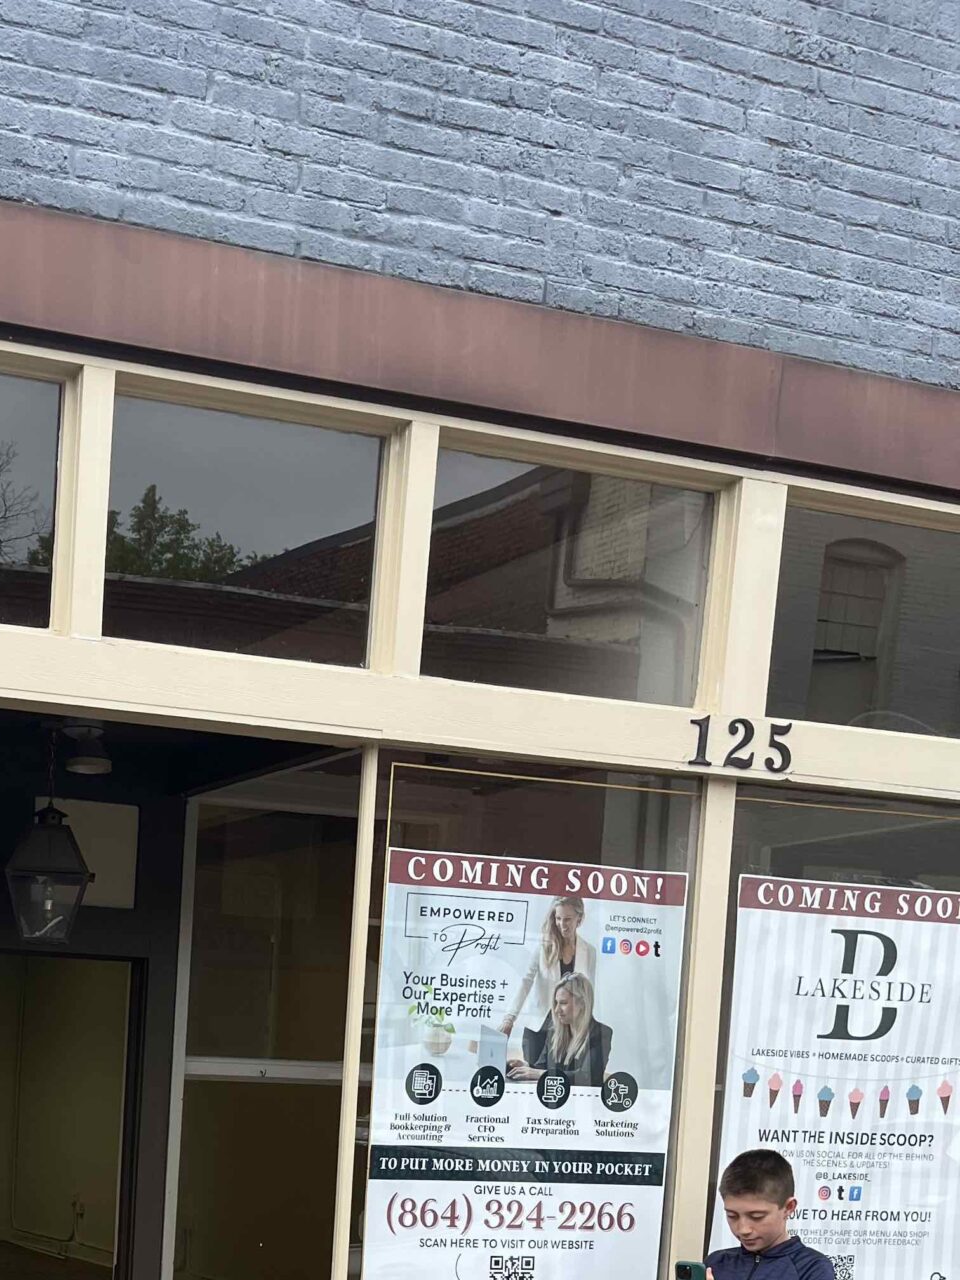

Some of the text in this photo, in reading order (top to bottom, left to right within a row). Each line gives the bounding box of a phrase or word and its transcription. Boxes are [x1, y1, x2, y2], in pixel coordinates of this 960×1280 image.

[688, 715, 792, 773] 125
[407, 856, 664, 900] COMING SOON!
[757, 882, 881, 913] COMING
[420, 906, 514, 922] EMPOWERED
[610, 914, 657, 924] LET'S CONNECT
[433, 924, 501, 967] TO Profit
[403, 971, 436, 986] Your
[440, 973, 497, 990] Business
[817, 929, 898, 1041] B
[402, 986, 429, 1000] Our
[433, 988, 494, 1006] Expertise
[794, 976, 933, 1004] LAKESIDE
[416, 1002, 492, 1018] More Profit
[751, 1048, 788, 1058] LAKESIDE
[790, 1050, 810, 1059] VIBES
[818, 1052, 868, 1062] HOMEMADE
[870, 1054, 900, 1063] SCOOPS
[905, 1056, 940, 1065] CURATED
[466, 1114, 510, 1124] Fractional
[526, 1117, 576, 1129] Tax Strategy
[594, 1120, 639, 1130] Marketing
[390, 1122, 442, 1133] Bookkeeping
[478, 1125, 495, 1134] CFO
[530, 1127, 580, 1137] Preparation
[595, 1129, 635, 1138] Solutions
[398, 1132, 444, 1143] Accounting
[468, 1134, 504, 1142] Services
[758, 1129, 935, 1148] WANT THE INSIDE SCOOP?
[816, 1150, 846, 1159] SOCIAL
[848, 1152, 863, 1160] FOR
[905, 1153, 934, 1162] BEHIND
[379, 1157, 653, 1176] TO PUT MORE MONEY IN YOUR POCKET
[816, 1160, 848, 1168] SCENES
[474, 1185, 553, 1196] GIVE US A CALL
[386, 1192, 636, 1236] (864) 324-2266
[812, 1209, 828, 1220] TO
[830, 1210, 862, 1221] HEAR
[865, 1210, 900, 1222] FROM
[904, 1212, 932, 1222] YOU!
[419, 1238, 594, 1250] SCAN HERE TO VISIT OUR WEBSITE
